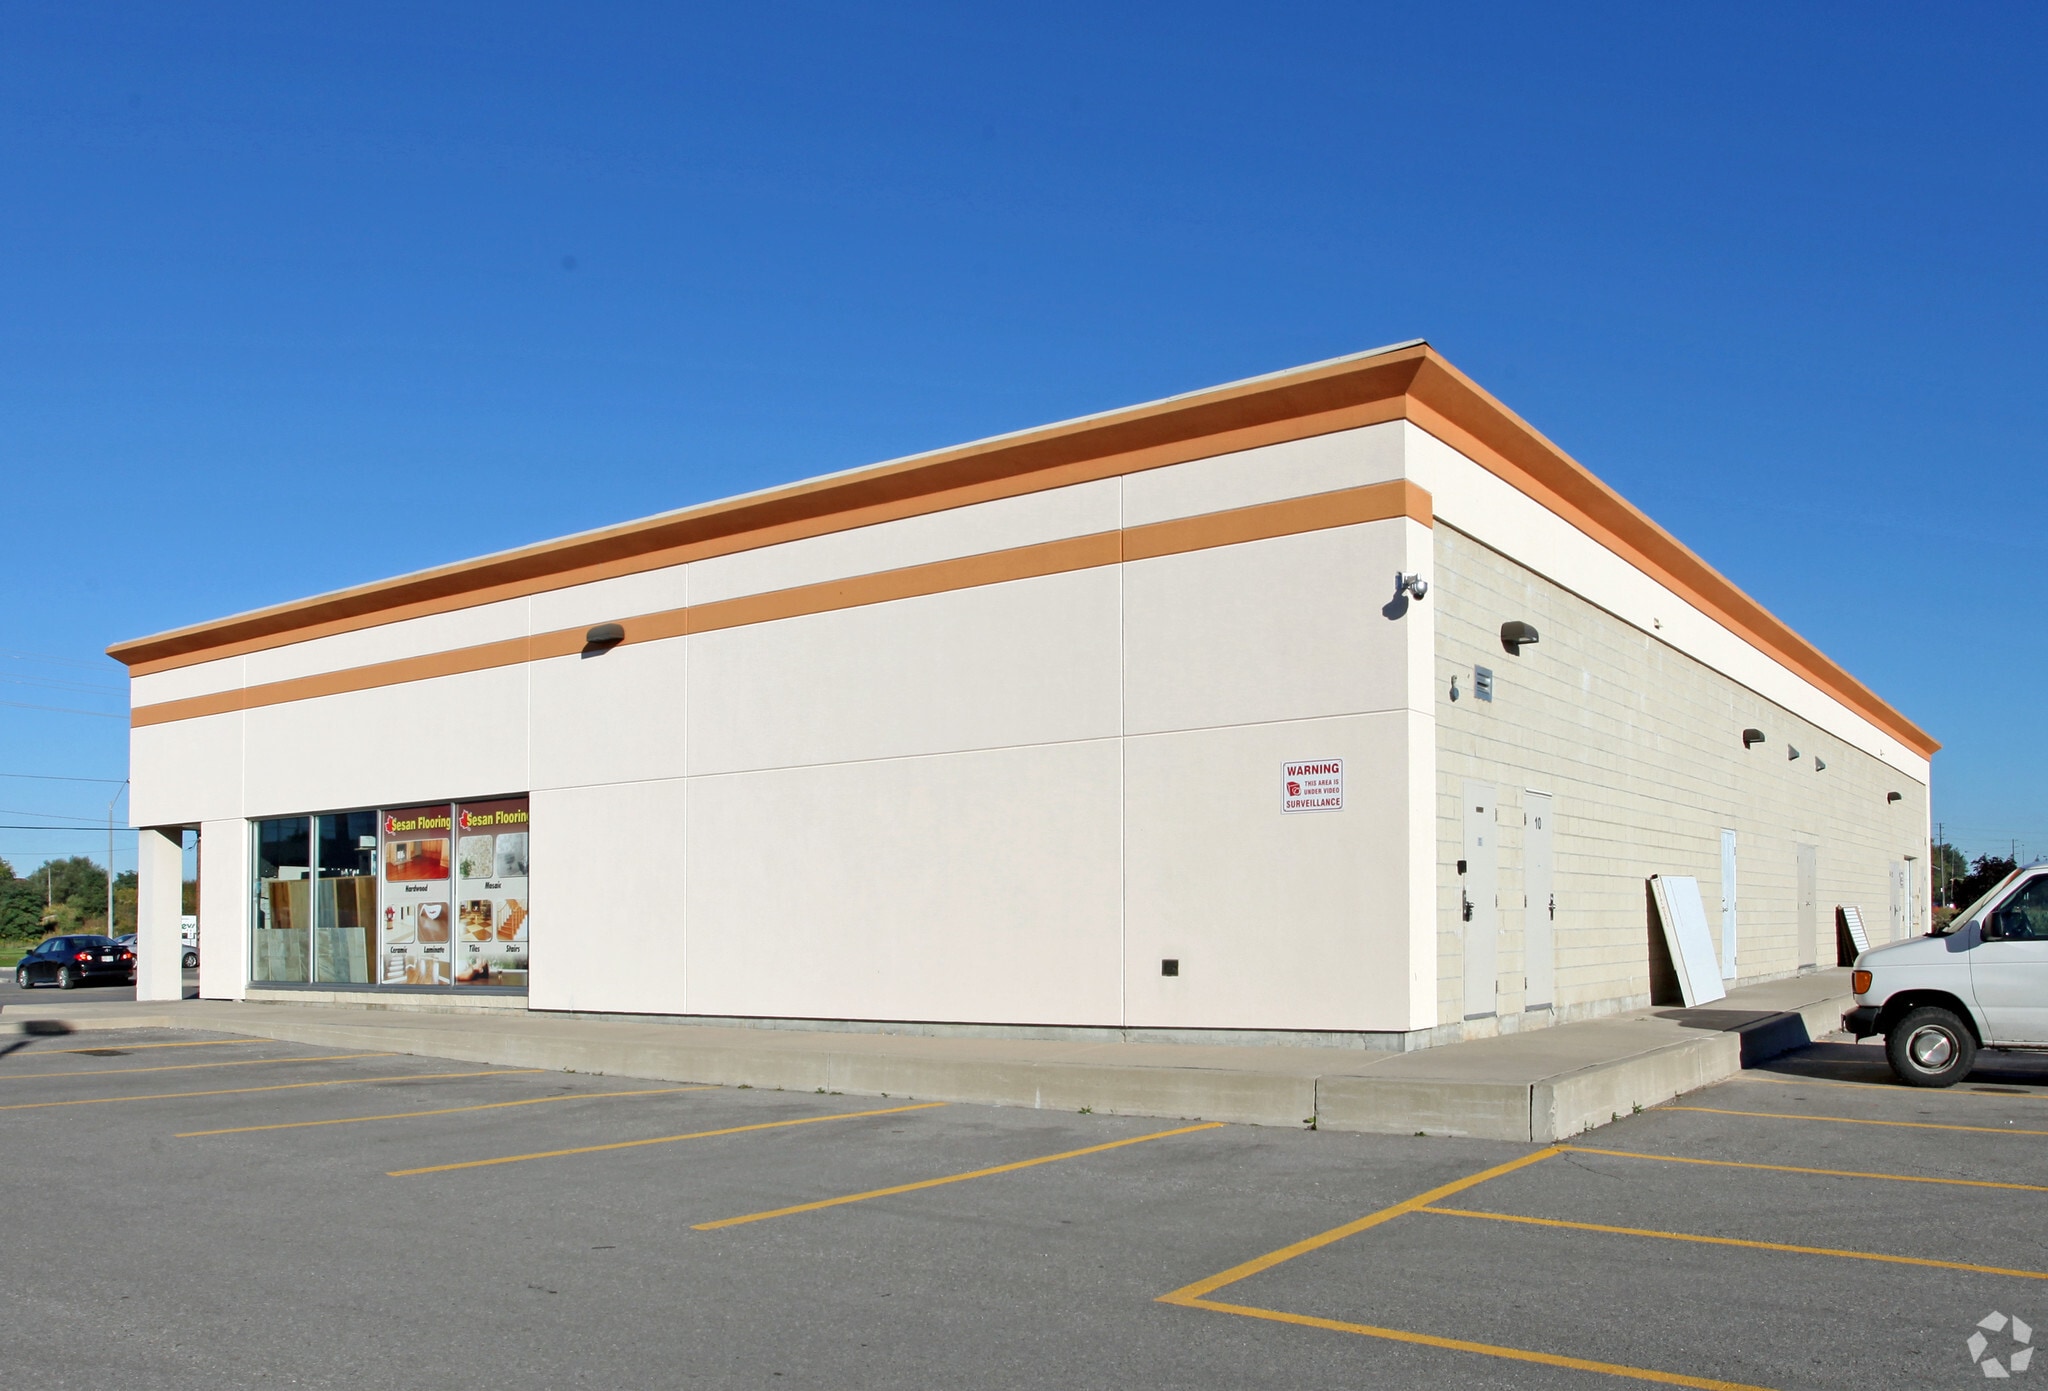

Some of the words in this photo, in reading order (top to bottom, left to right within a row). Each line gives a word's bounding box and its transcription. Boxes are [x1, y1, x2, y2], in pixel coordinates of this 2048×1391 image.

[1287, 764, 1339, 776] WARNING
[1286, 798, 1340, 808] SURVEILLANCE
[391, 818, 416, 831] Sesan
[418, 815, 451, 831] Flooring
[467, 812, 493, 826] Sesan
[1535, 817, 1541, 830] 10
[405, 884, 428, 892] Hardwood
[485, 881, 502, 890] Mosaic
[390, 946, 408, 954] Ceramic
[423, 946, 445, 954] Laminate
[469, 944, 480, 953] Tiles
[506, 945, 521, 953] Stairs
